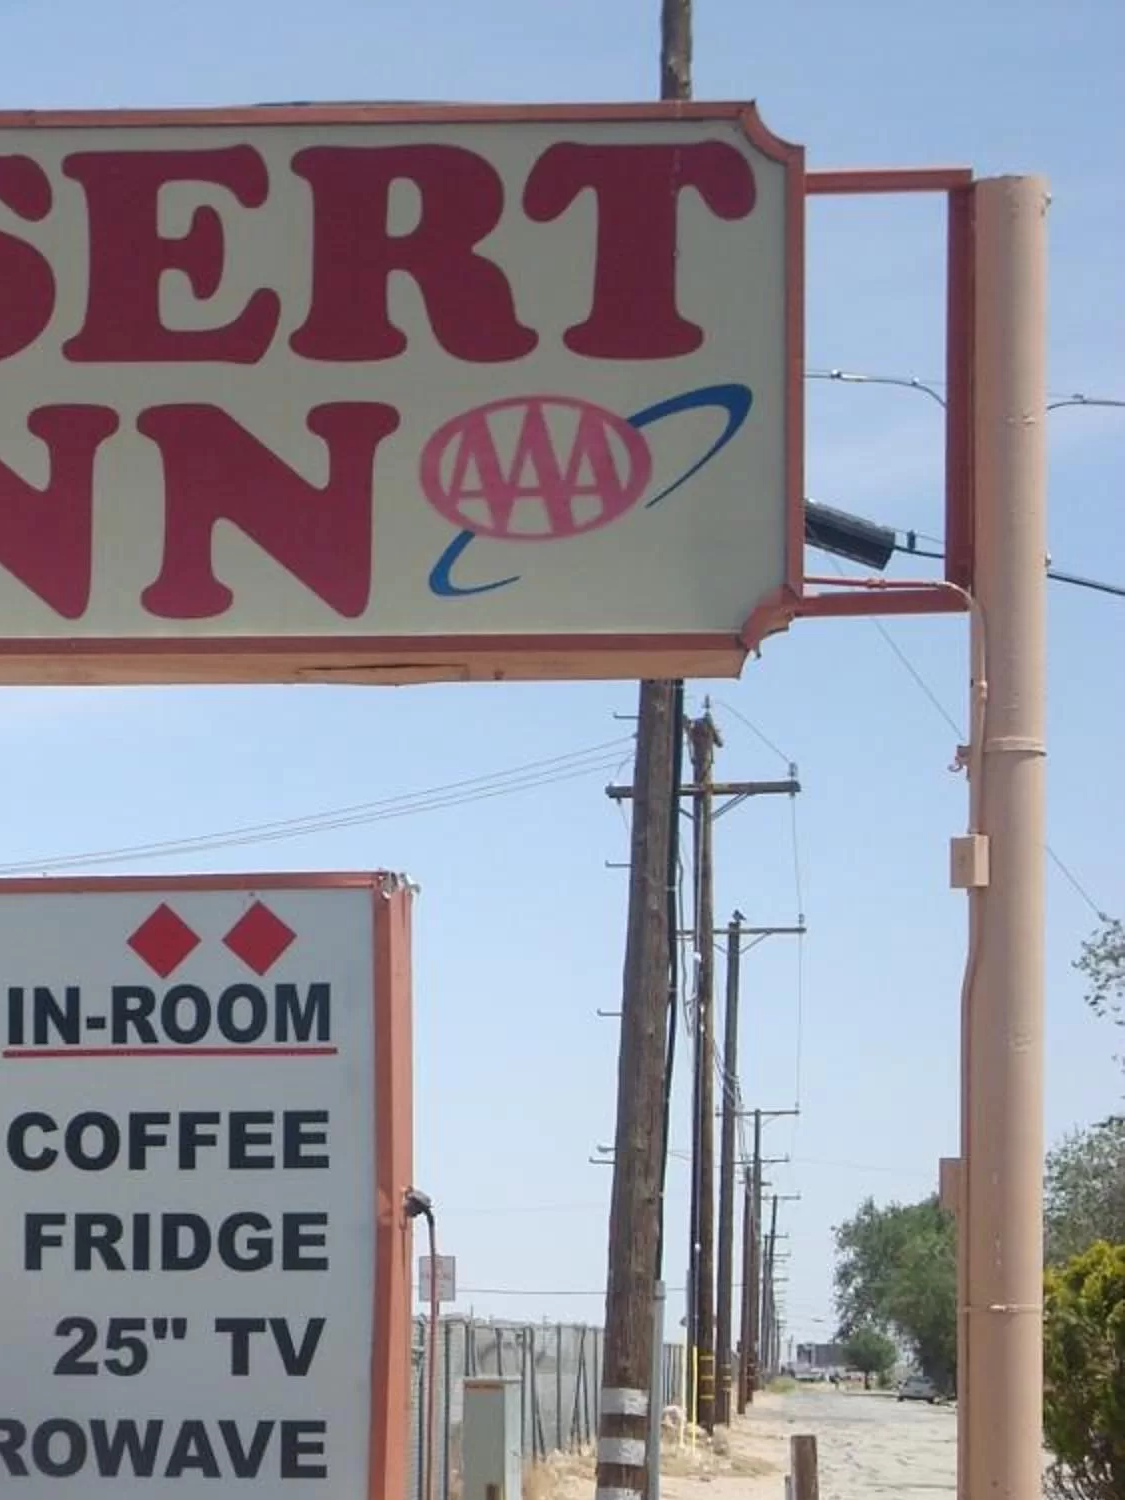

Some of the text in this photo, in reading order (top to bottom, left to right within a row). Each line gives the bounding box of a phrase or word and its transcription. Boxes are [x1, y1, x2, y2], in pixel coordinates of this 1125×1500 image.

[431, 396, 641, 538] AAA
[5, 984, 333, 1046] IN-ROOM
[5, 1110, 331, 1172] COFFEE
[23, 1211, 330, 1273] FRIDGE
[53, 1316, 326, 1377] 25" TV
